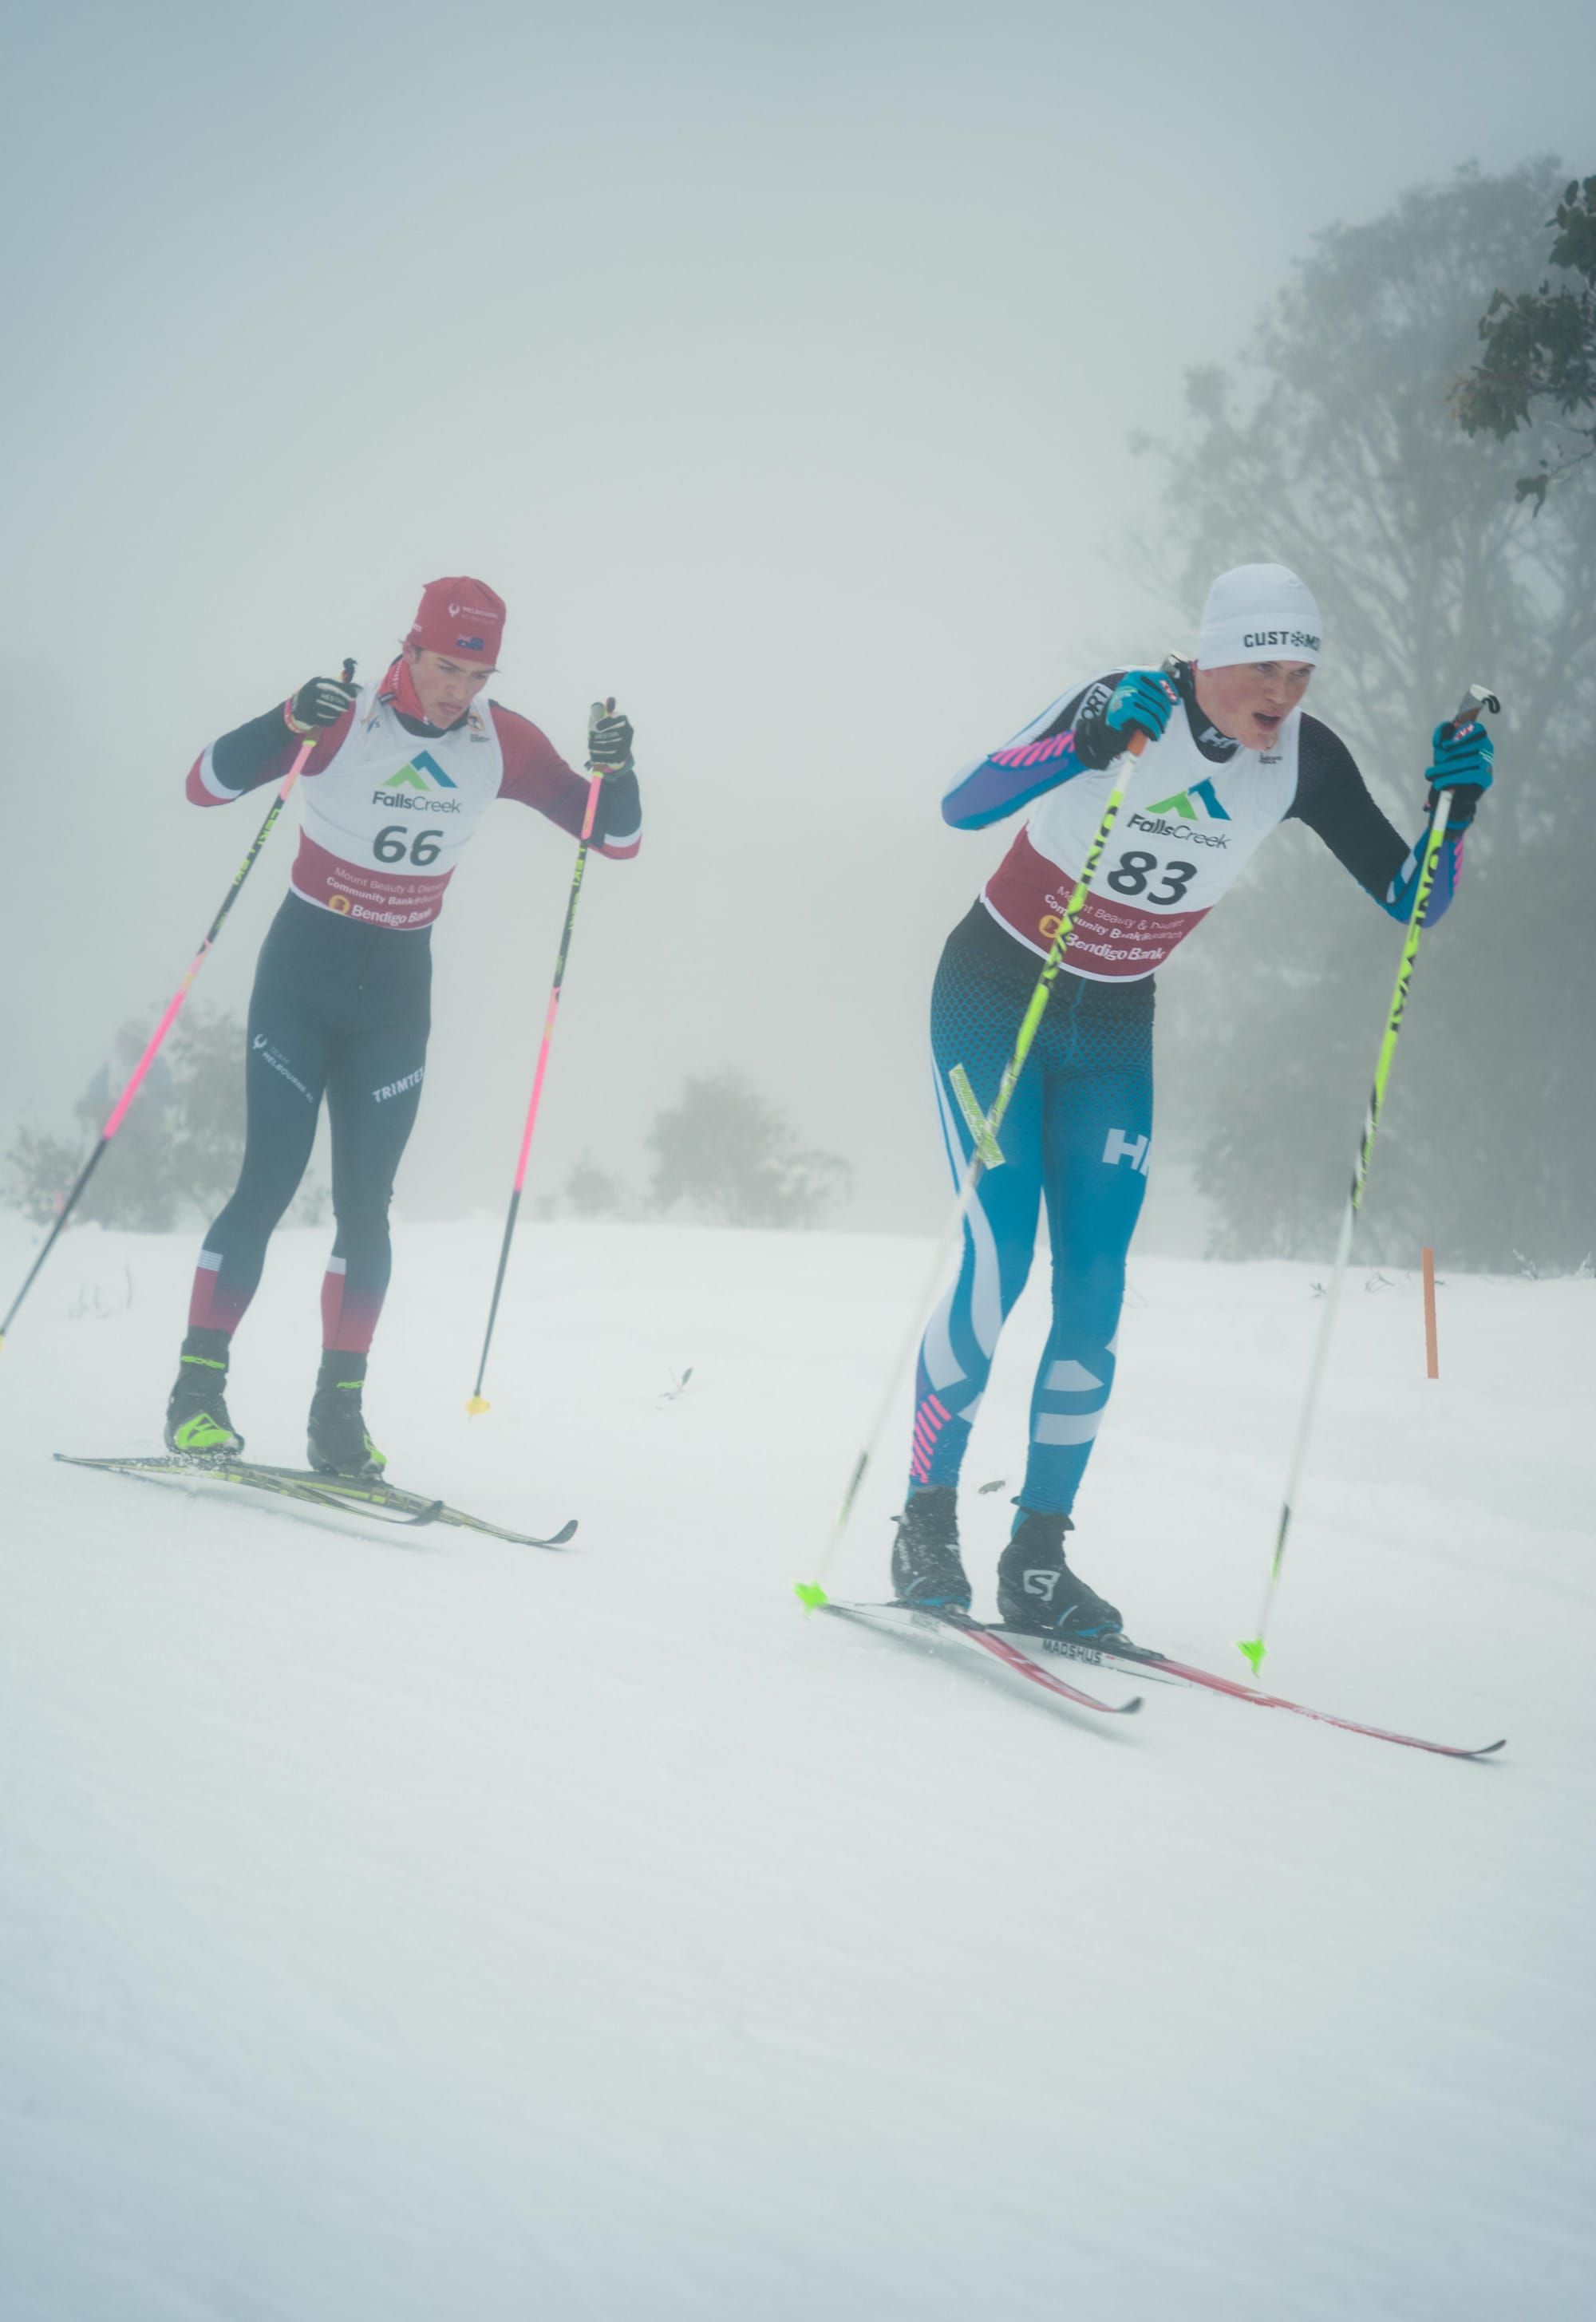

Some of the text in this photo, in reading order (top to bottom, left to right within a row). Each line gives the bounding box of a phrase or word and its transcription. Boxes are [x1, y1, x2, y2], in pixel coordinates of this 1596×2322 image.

[1081, 685, 1108, 720] ORT
[372, 791, 462, 813] FallsCreek
[1127, 813, 1232, 849] FallsCreek
[373, 825, 444, 866] 66
[326, 877, 385, 904] Community
[335, 867, 368, 887] Mount
[369, 880, 405, 894] Beauty
[1107, 851, 1198, 905] 83
[351, 904, 406, 926] Bendigo
[1057, 886, 1094, 914] Mont
[1093, 908, 1136, 928] Beauty
[1137, 919, 1148, 930] &
[1127, 947, 1166, 960] Bank
[1042, 1638, 1103, 1664] MADSHUS
